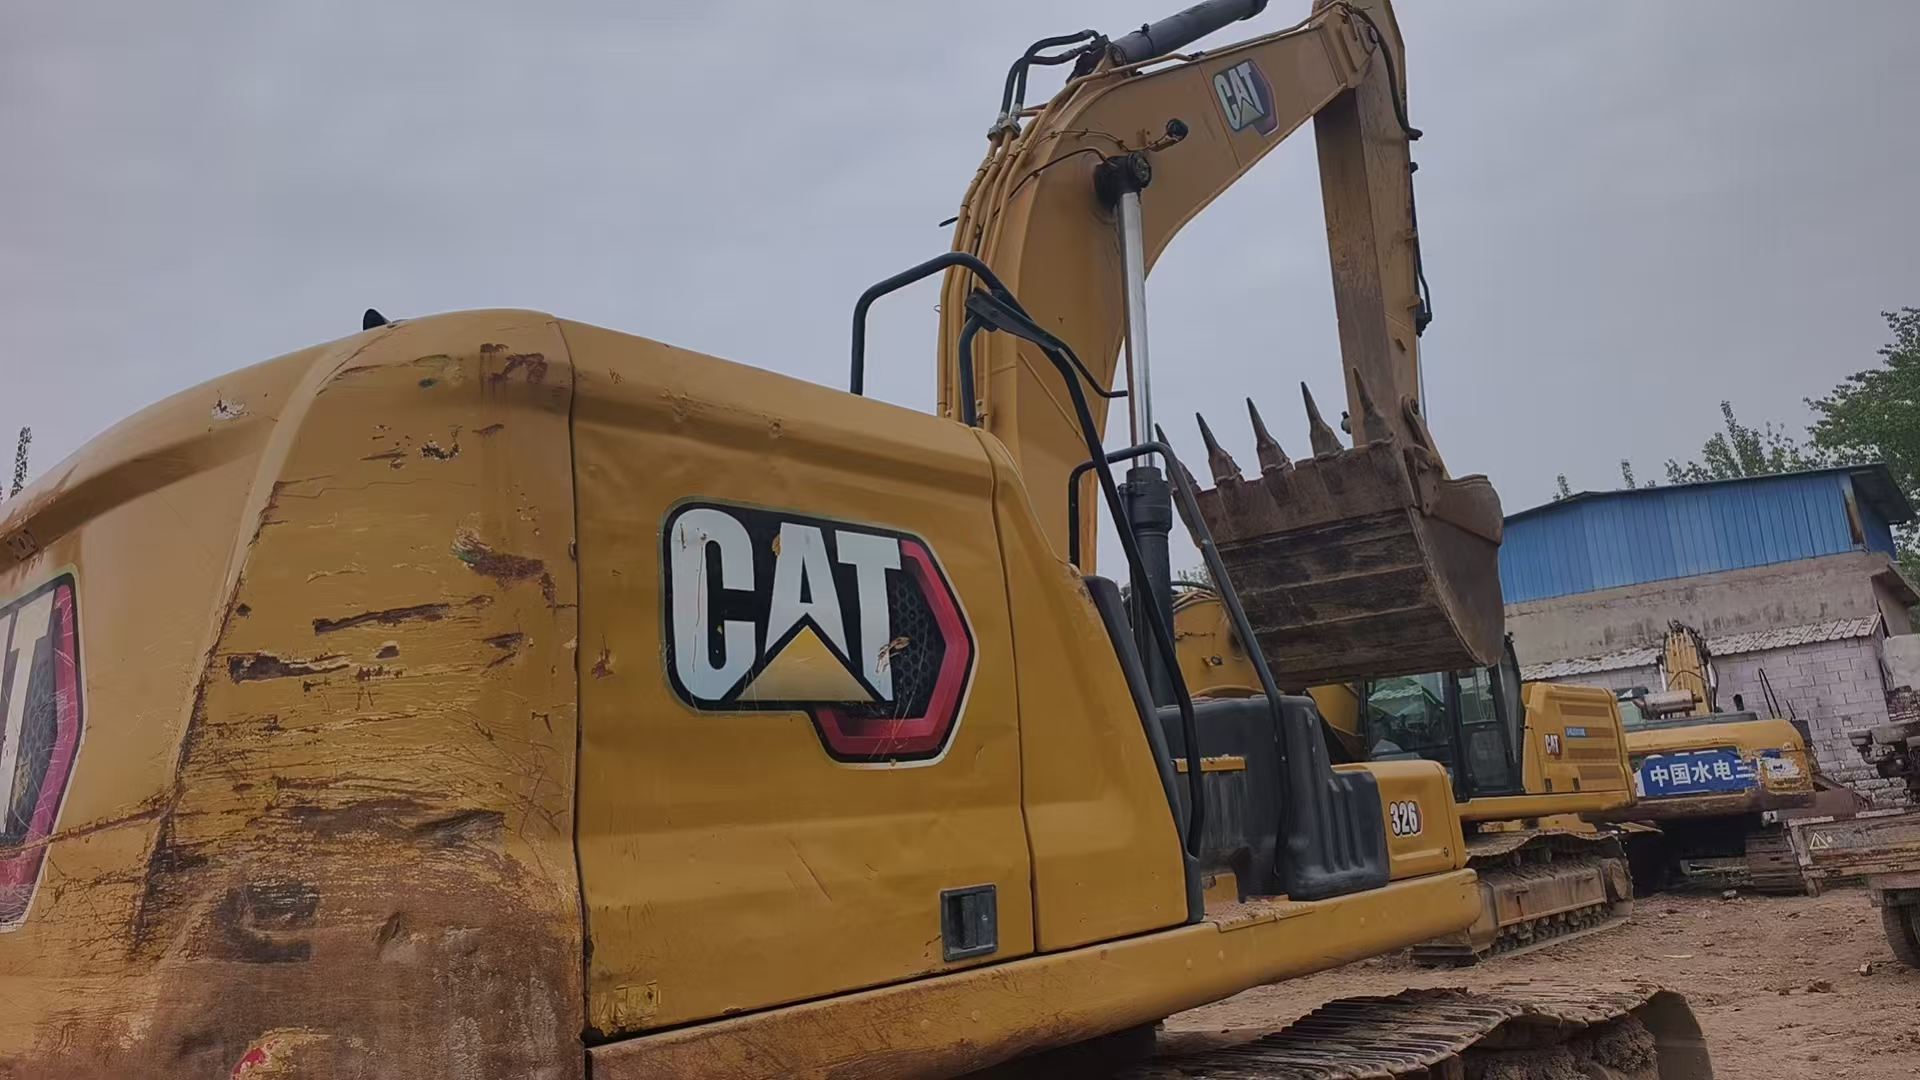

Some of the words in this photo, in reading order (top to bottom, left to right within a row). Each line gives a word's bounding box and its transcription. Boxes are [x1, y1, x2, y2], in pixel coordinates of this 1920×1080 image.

[1214, 61, 1265, 130] CAT
[671, 507, 903, 703] CAT
[1544, 734, 1560, 755] CAT
[1389, 801, 1419, 836] 326
